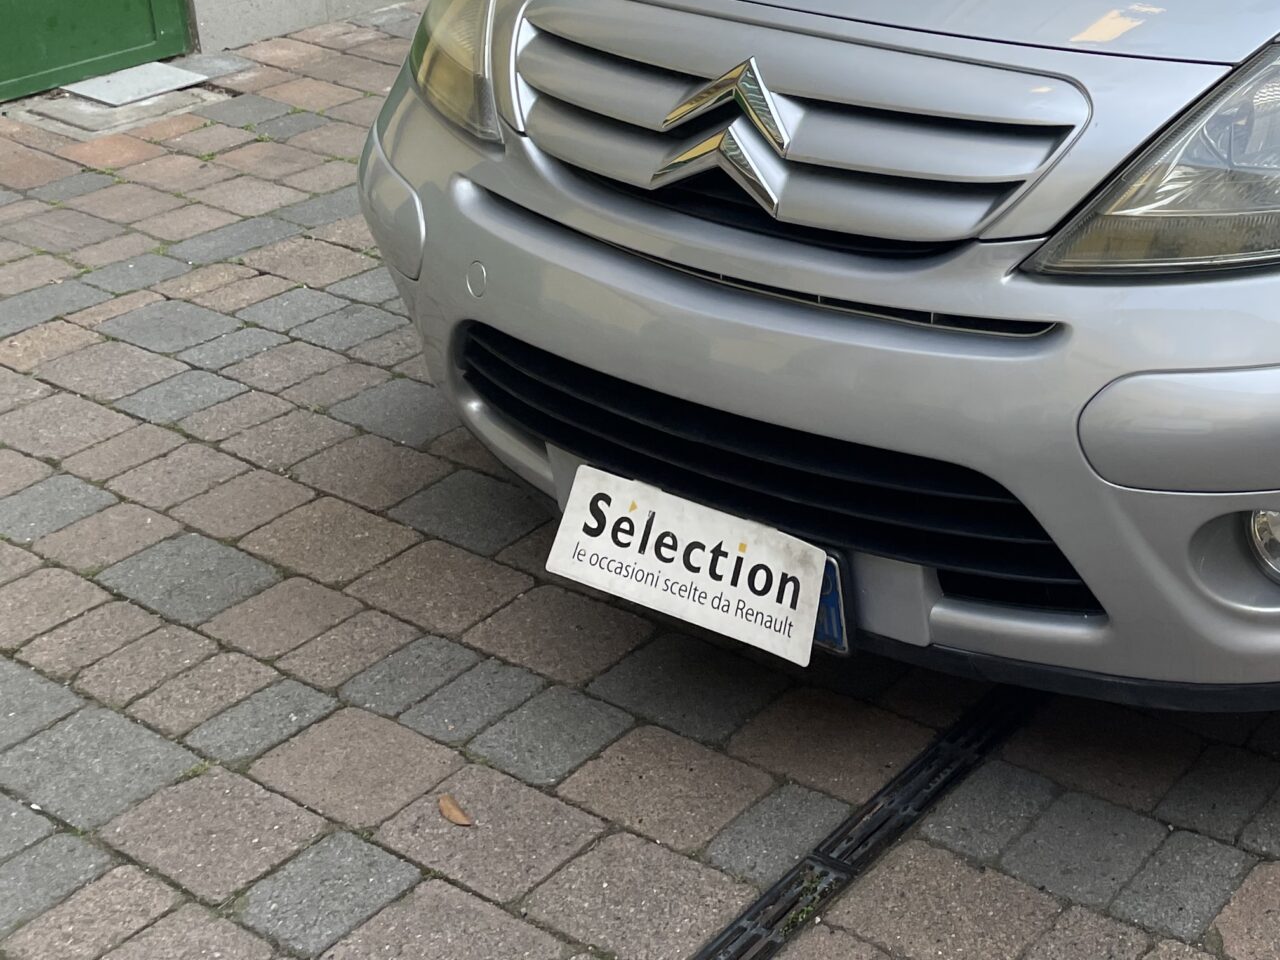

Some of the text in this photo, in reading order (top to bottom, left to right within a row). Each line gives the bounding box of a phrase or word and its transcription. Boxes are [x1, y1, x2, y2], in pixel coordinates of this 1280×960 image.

[572, 541, 794, 639] le occasioni scelte da Renault
